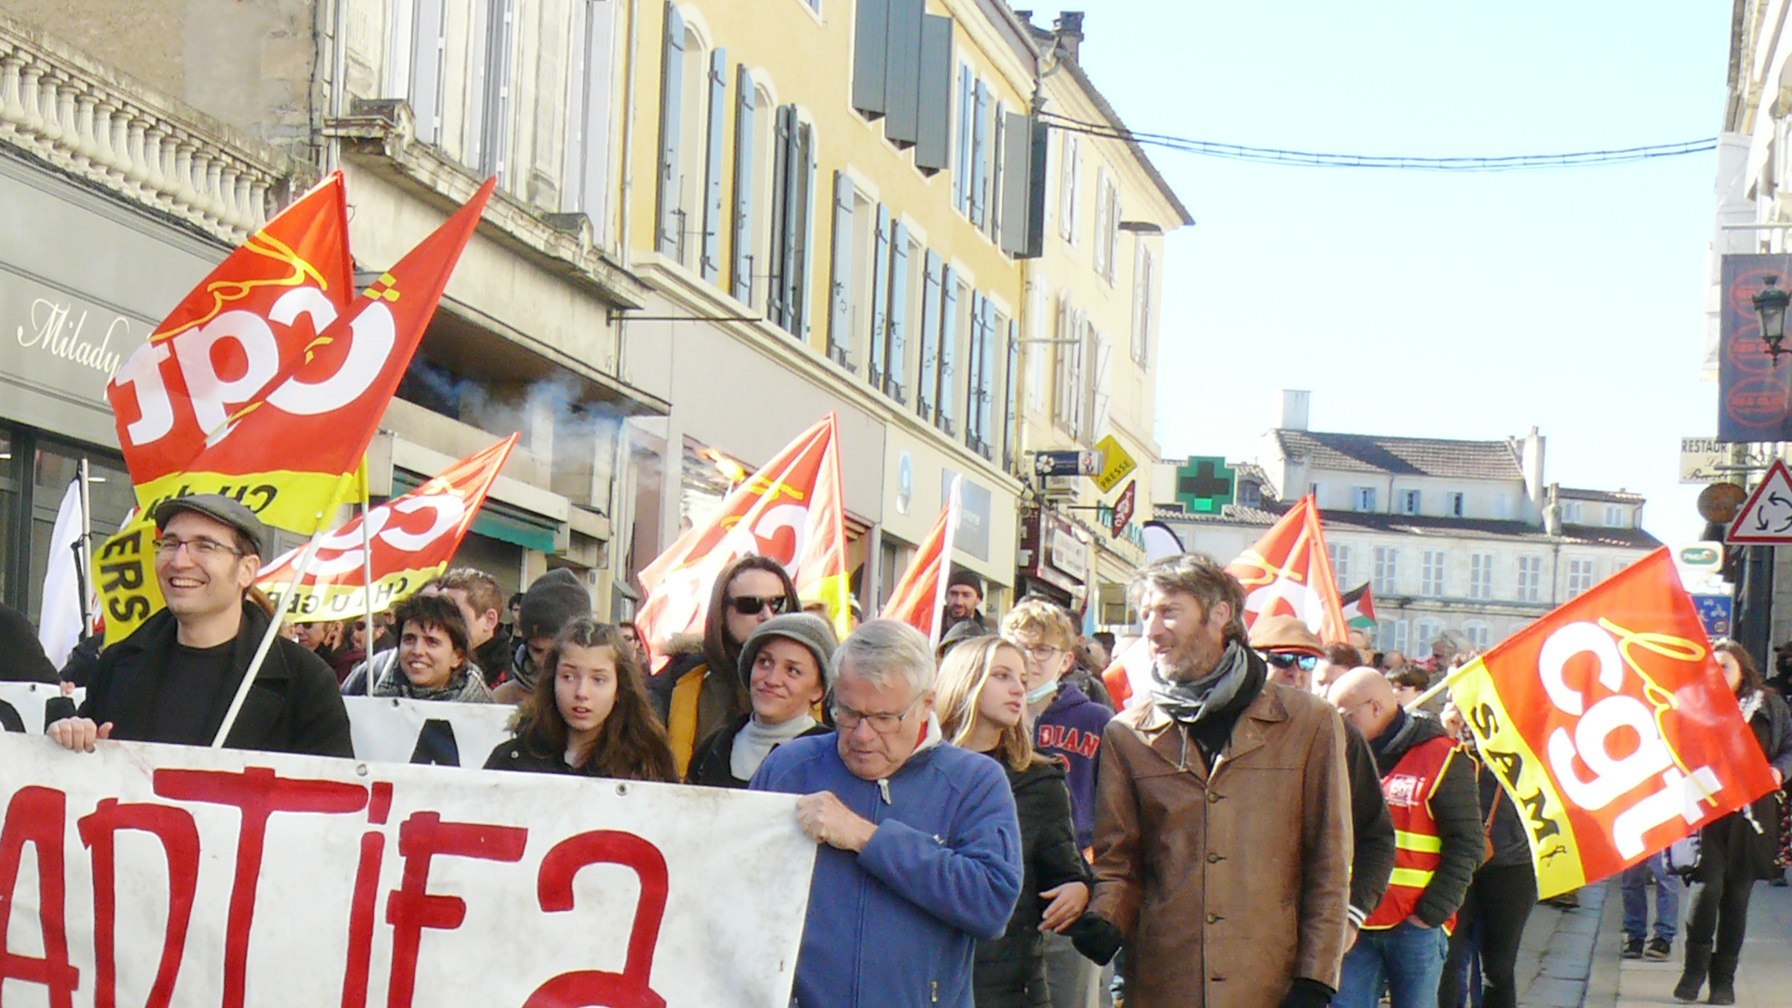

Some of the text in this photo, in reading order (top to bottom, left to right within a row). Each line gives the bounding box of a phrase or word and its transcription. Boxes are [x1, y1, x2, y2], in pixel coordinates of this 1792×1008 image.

[16, 298, 131, 401] Milady
[1100, 460, 1131, 489] PRESSE
[1539, 621, 1723, 860] cgt
